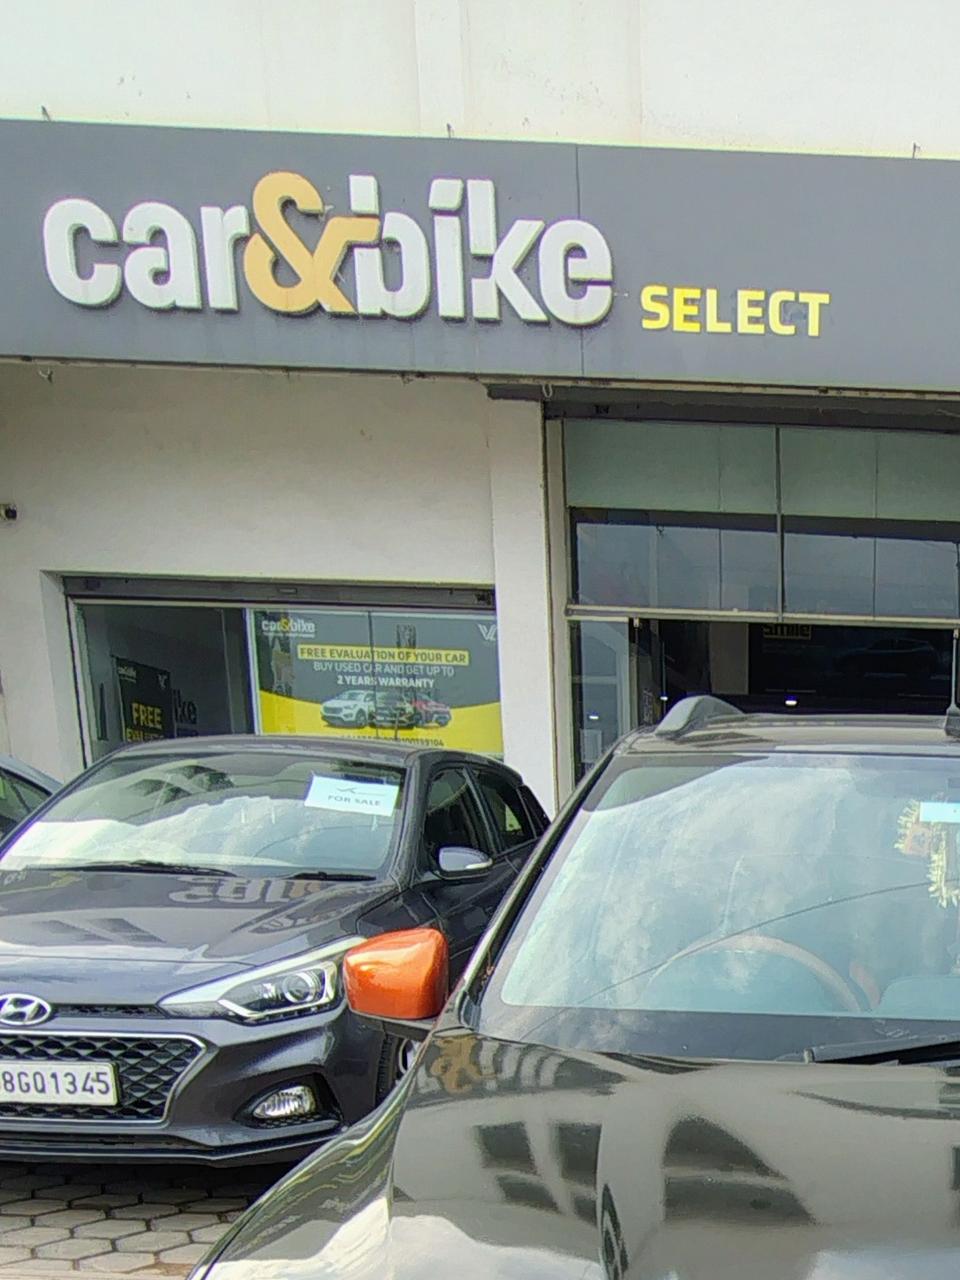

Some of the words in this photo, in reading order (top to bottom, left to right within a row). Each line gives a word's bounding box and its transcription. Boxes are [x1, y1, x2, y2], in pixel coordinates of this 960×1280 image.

[42, 170, 614, 326] car&bike
[641, 283, 831, 338] SELECT
[300, 647, 327, 658] FREE
[398, 651, 412, 661] OF
[414, 651, 442, 662] YOUR
[445, 652, 466, 663] CAR
[313, 661, 333, 671] BUY
[335, 662, 361, 672] USED
[384, 664, 404, 674] AND
[337, 674, 344, 684] 2
[378, 676, 435, 689] WARRANTY
[132, 702, 162, 730] FREE
[328, 795, 351, 803] FOR
[355, 798, 381, 807] SALE
